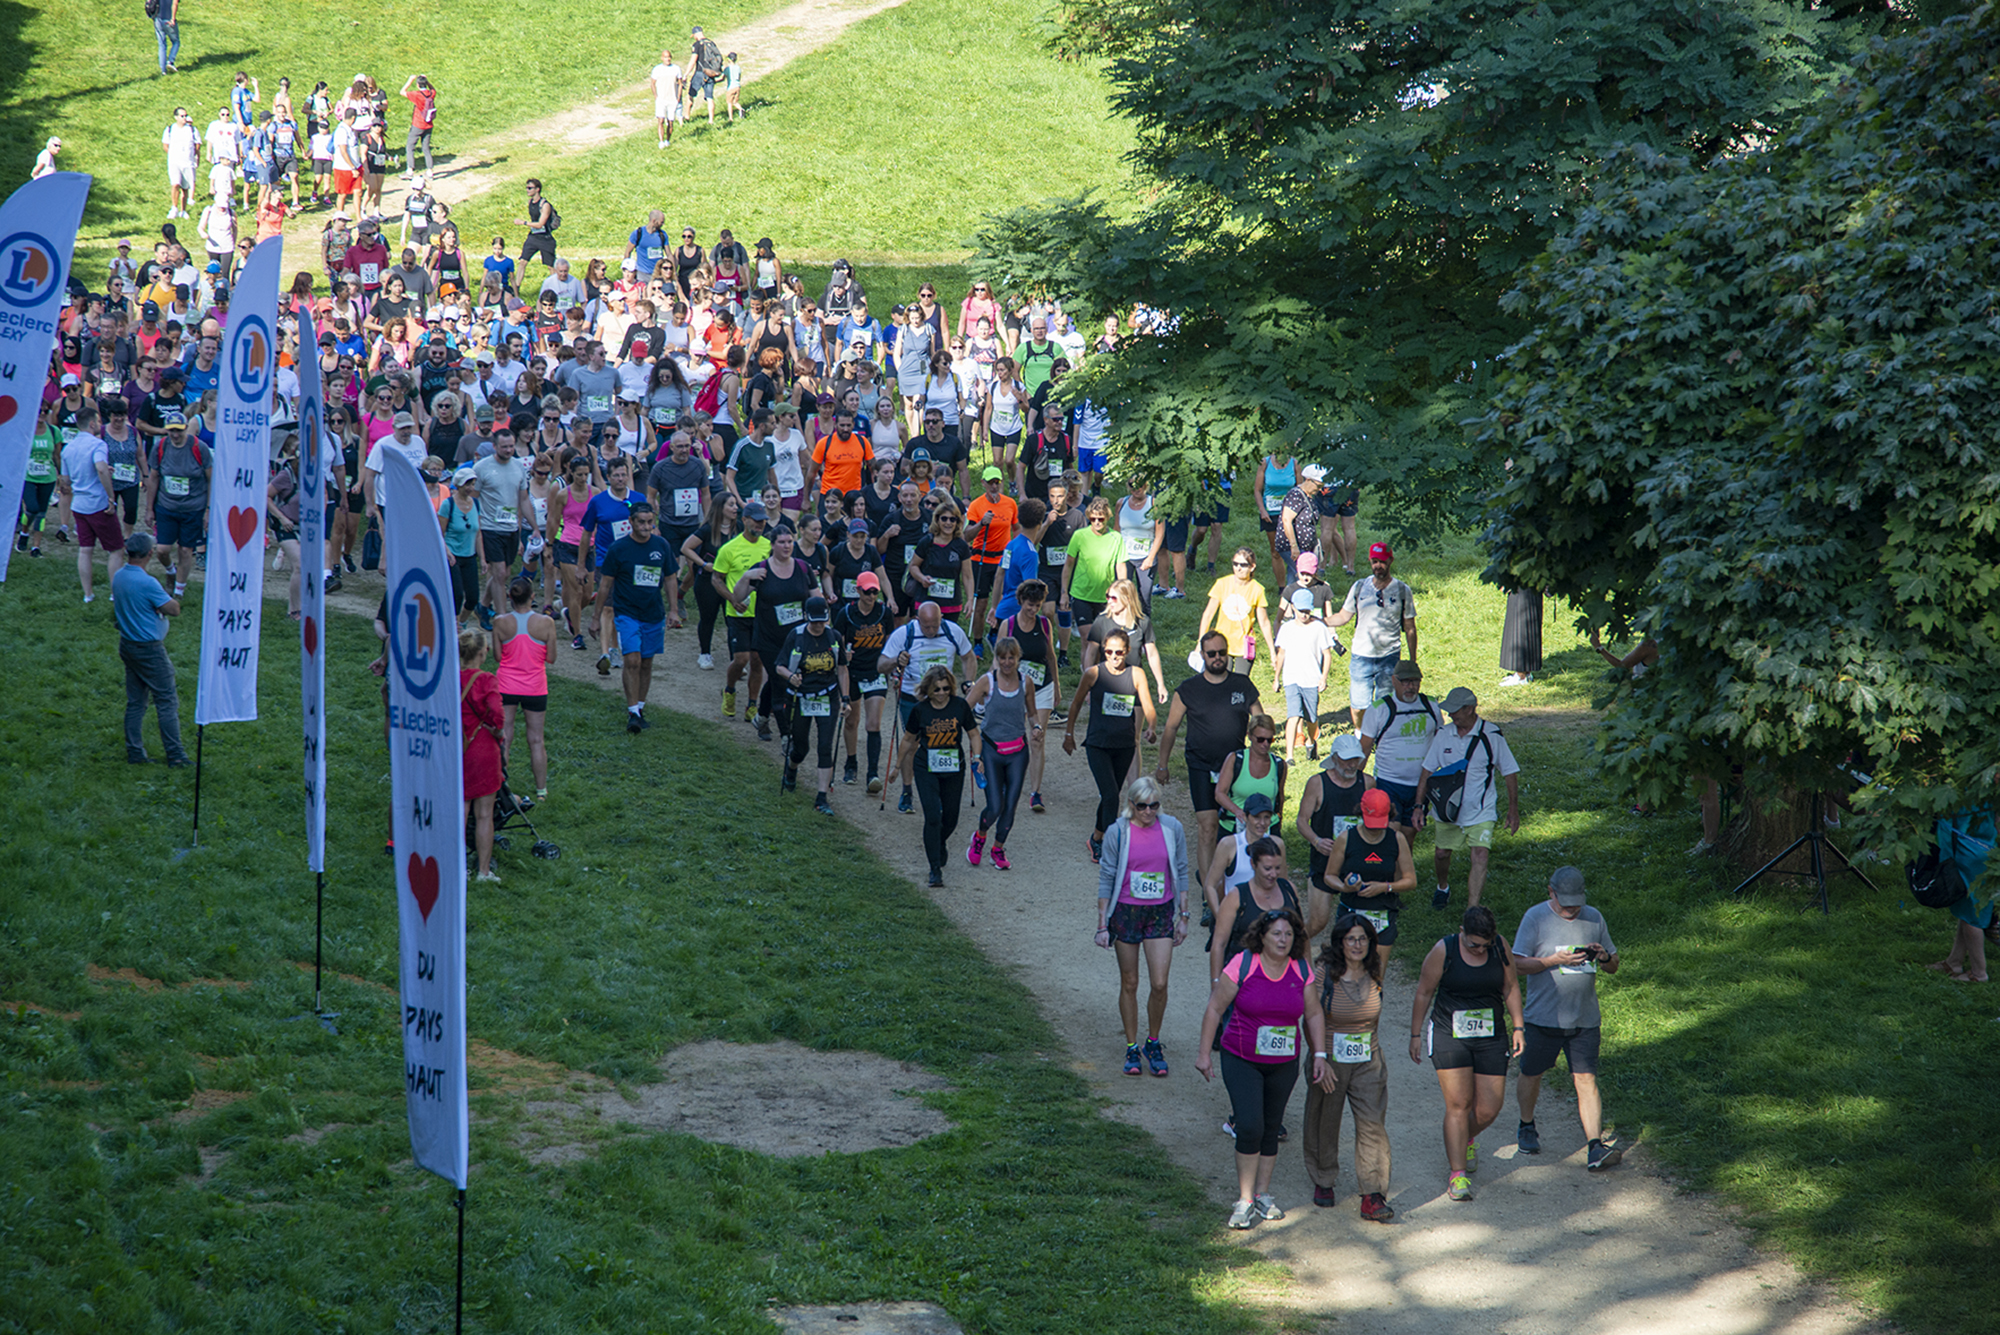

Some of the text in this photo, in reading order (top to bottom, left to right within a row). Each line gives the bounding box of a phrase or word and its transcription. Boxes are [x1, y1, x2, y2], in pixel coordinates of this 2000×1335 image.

[365, 274, 376, 282] 35
[0, 326, 28, 342] EXY
[0, 361, 17, 381] U
[234, 468, 254, 490] AU
[684, 503, 691, 514] 2
[230, 571, 247, 593] DU
[642, 572, 654, 581] 642
[218, 647, 252, 670] AUT
[1112, 701, 1126, 711] 685
[390, 705, 451, 737] E.Leclerc
[939, 757, 952, 767] 683
[413, 795, 433, 831] AU
[1142, 881, 1158, 893] 645
[418, 950, 436, 980] DU
[405, 1005, 444, 1043] PAYS
[1467, 1020, 1484, 1031] 574
[1271, 1036, 1287, 1049] 691
[1346, 1043, 1364, 1057] 690
[406, 1062, 446, 1102] HAUT
